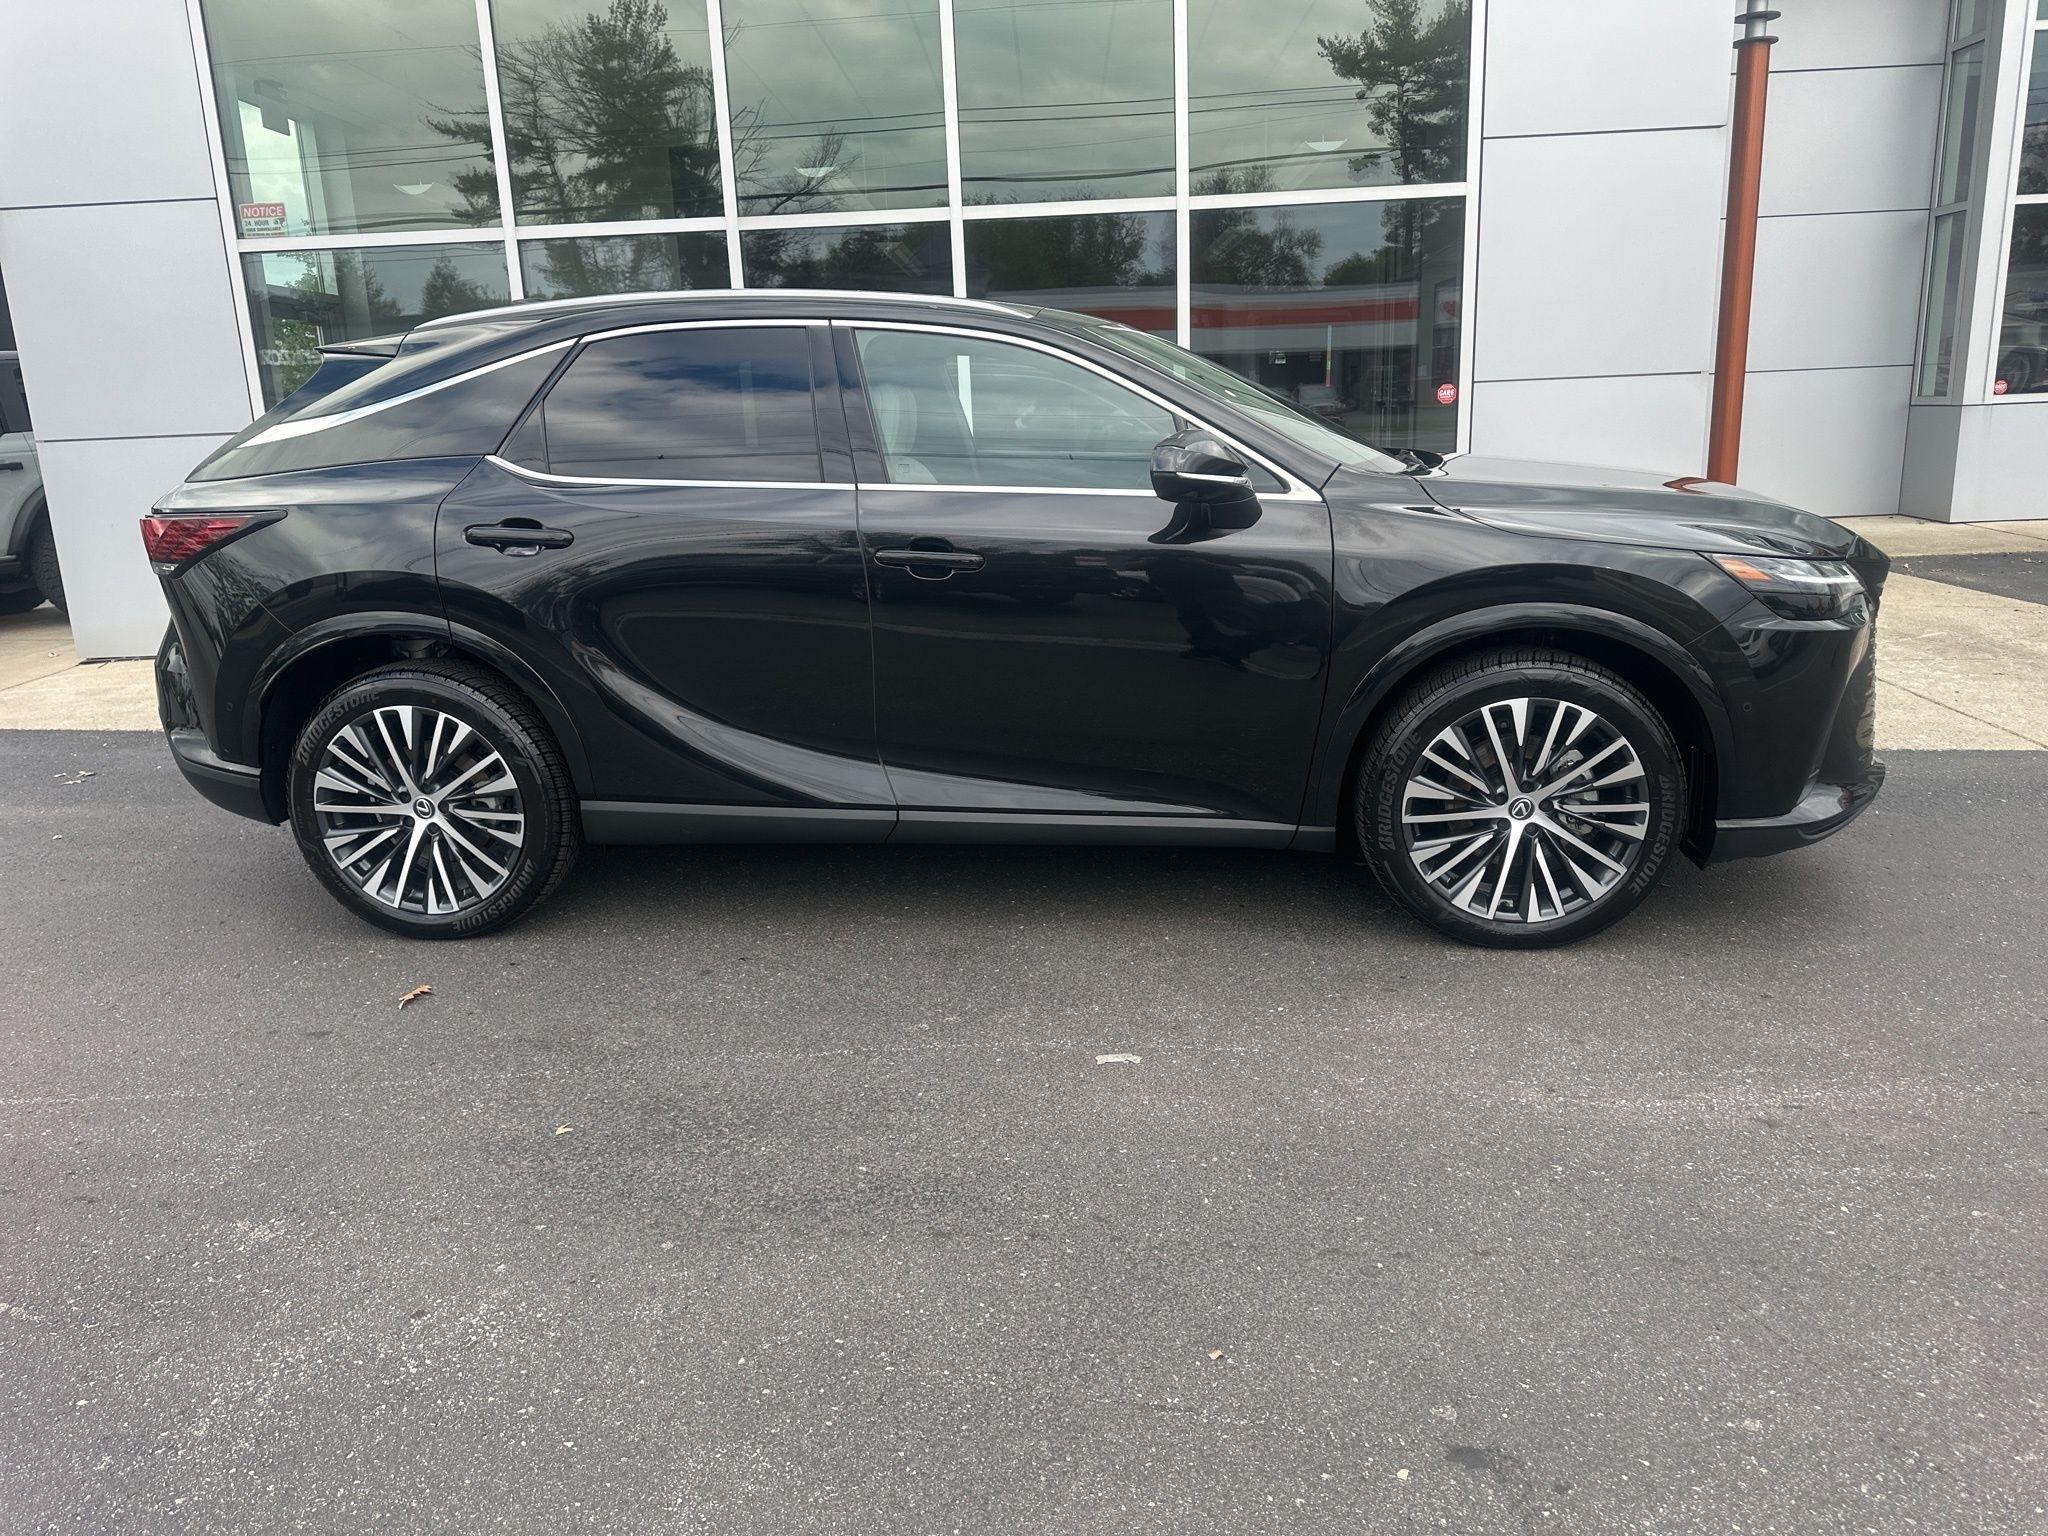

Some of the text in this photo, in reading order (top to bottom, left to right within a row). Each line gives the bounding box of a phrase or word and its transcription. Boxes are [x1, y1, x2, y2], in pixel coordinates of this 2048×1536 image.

[243, 206, 284, 218] NOTICE
[300, 687, 381, 766] BRIDGESTONE
[1378, 731, 1422, 851] BRIDGESTONE
[1627, 774, 1677, 897] BRIDGESTONE
[451, 858, 539, 932] BRIDGESTONE
